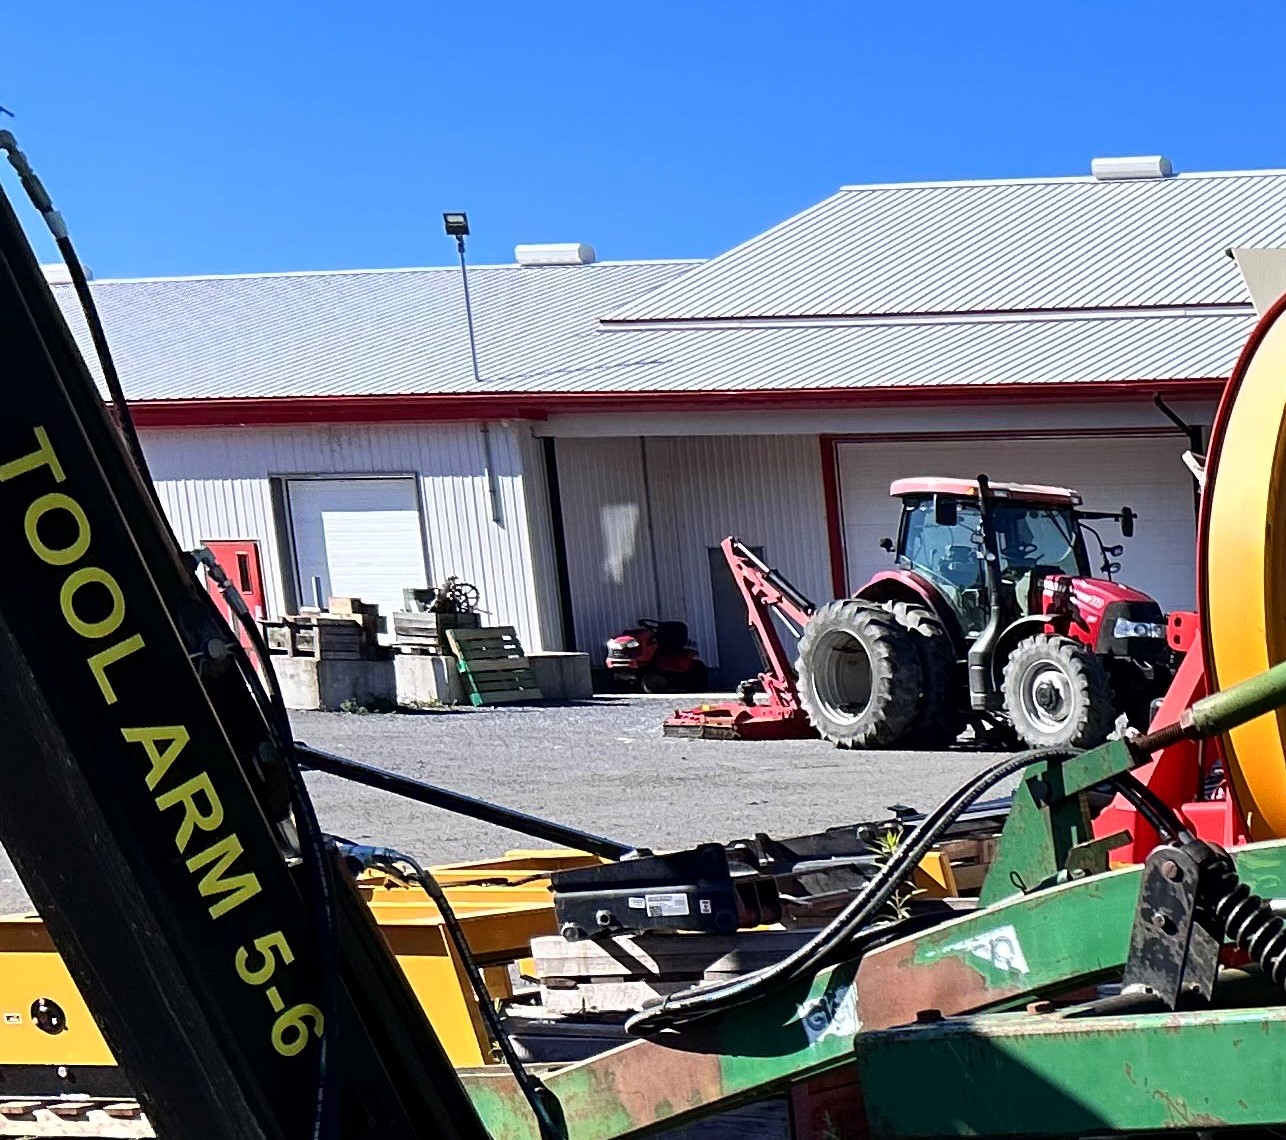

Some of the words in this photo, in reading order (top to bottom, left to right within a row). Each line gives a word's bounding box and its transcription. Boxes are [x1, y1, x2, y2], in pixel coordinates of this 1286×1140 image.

[0, 425, 146, 705] TOOL
[121, 724, 263, 920] ARM
[235, 930, 325, 1058] 5-6
